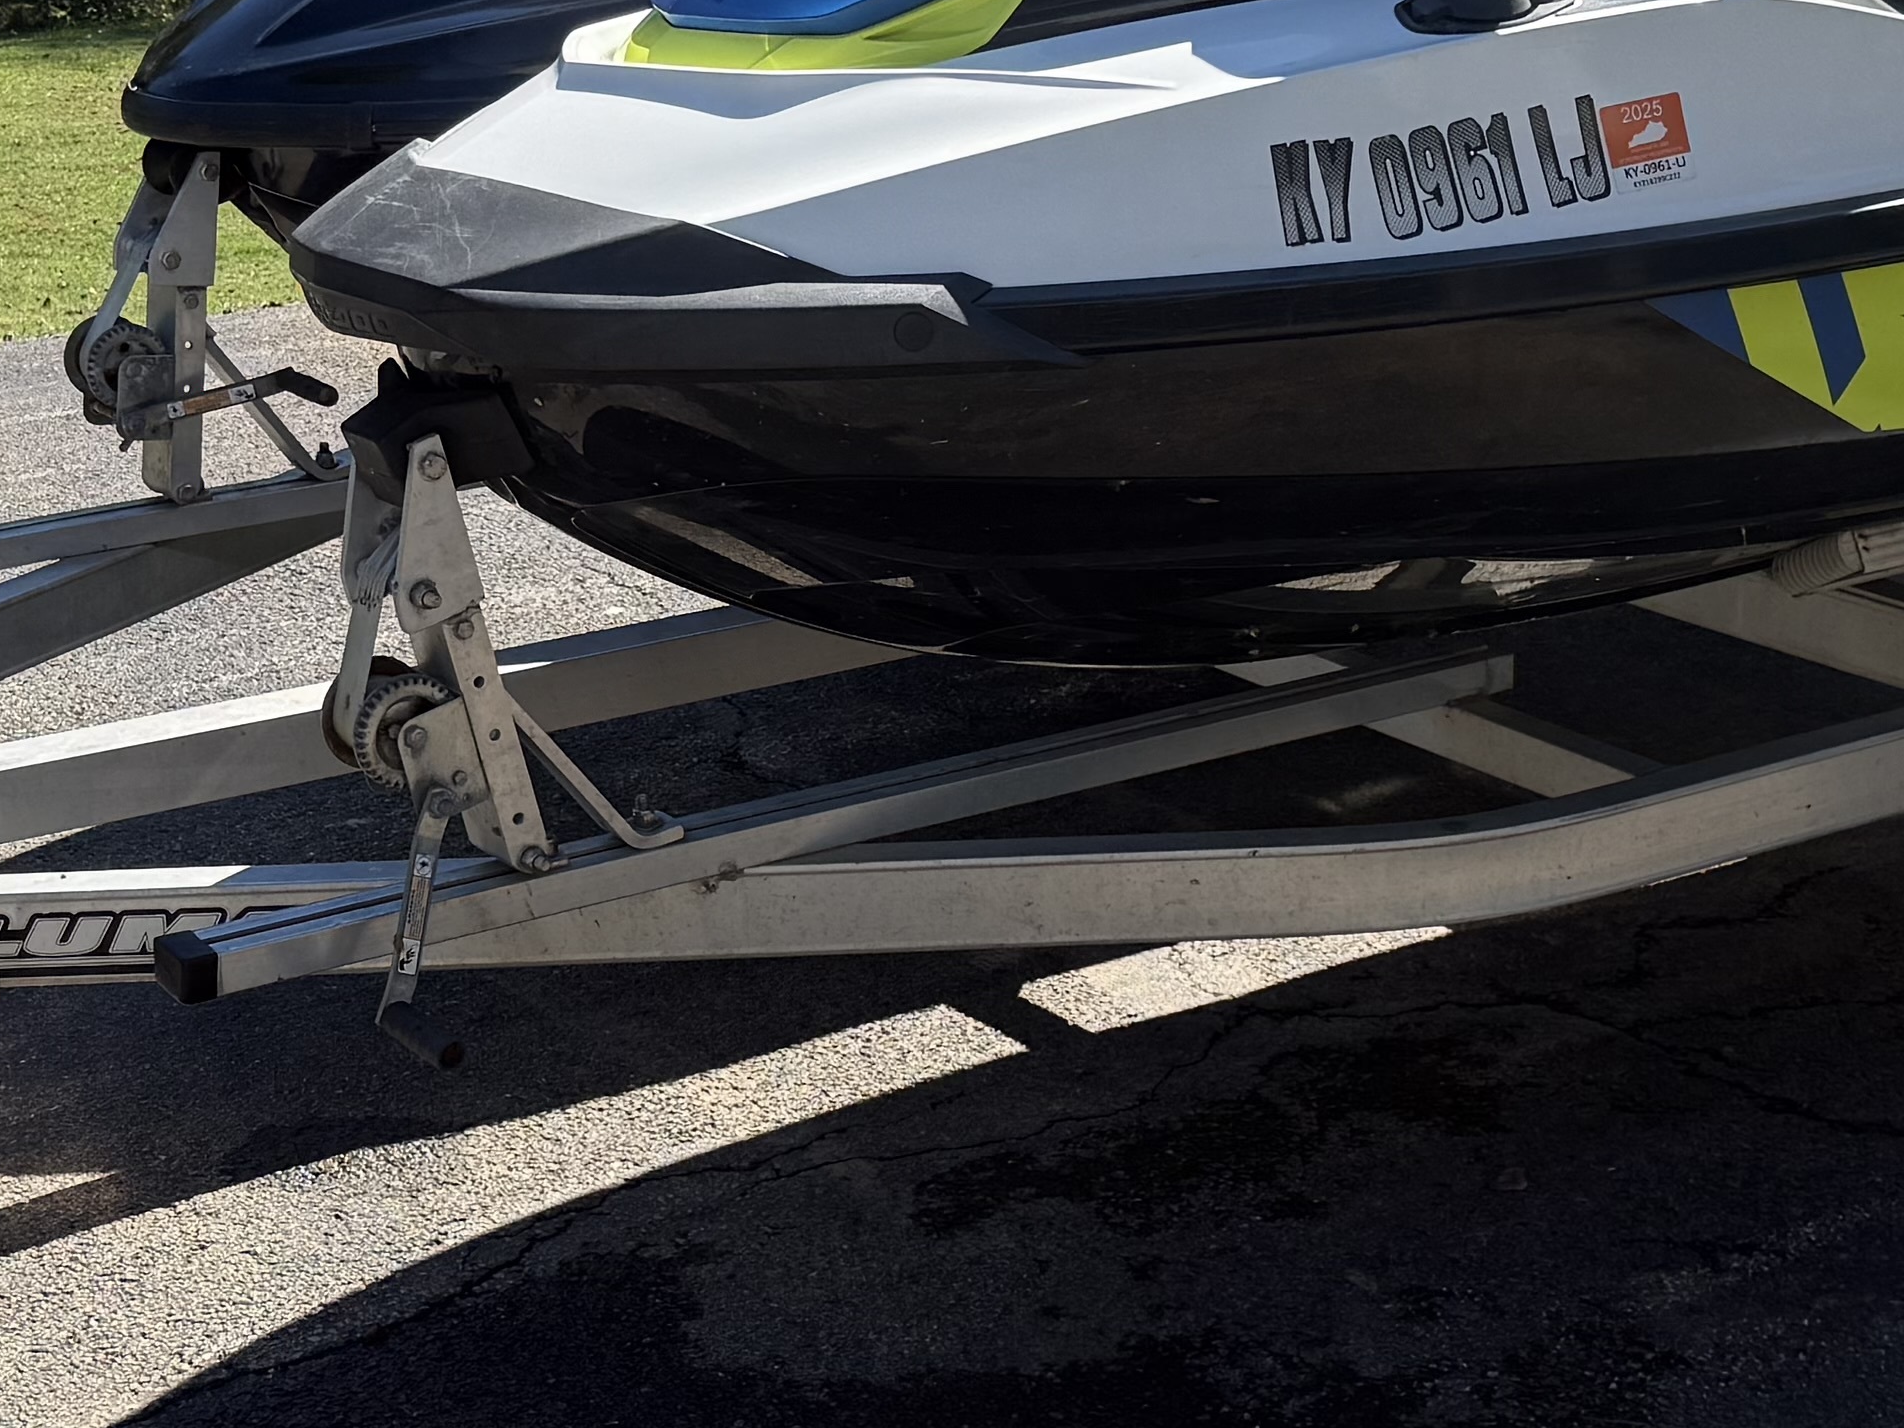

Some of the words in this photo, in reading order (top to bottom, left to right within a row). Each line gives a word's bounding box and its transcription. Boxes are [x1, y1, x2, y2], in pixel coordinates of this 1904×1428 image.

[1620, 100, 1663, 124] 2025
[1270, 136, 1353, 247] KY
[1369, 112, 1529, 241] 0961
[1527, 93, 1611, 209] LJ
